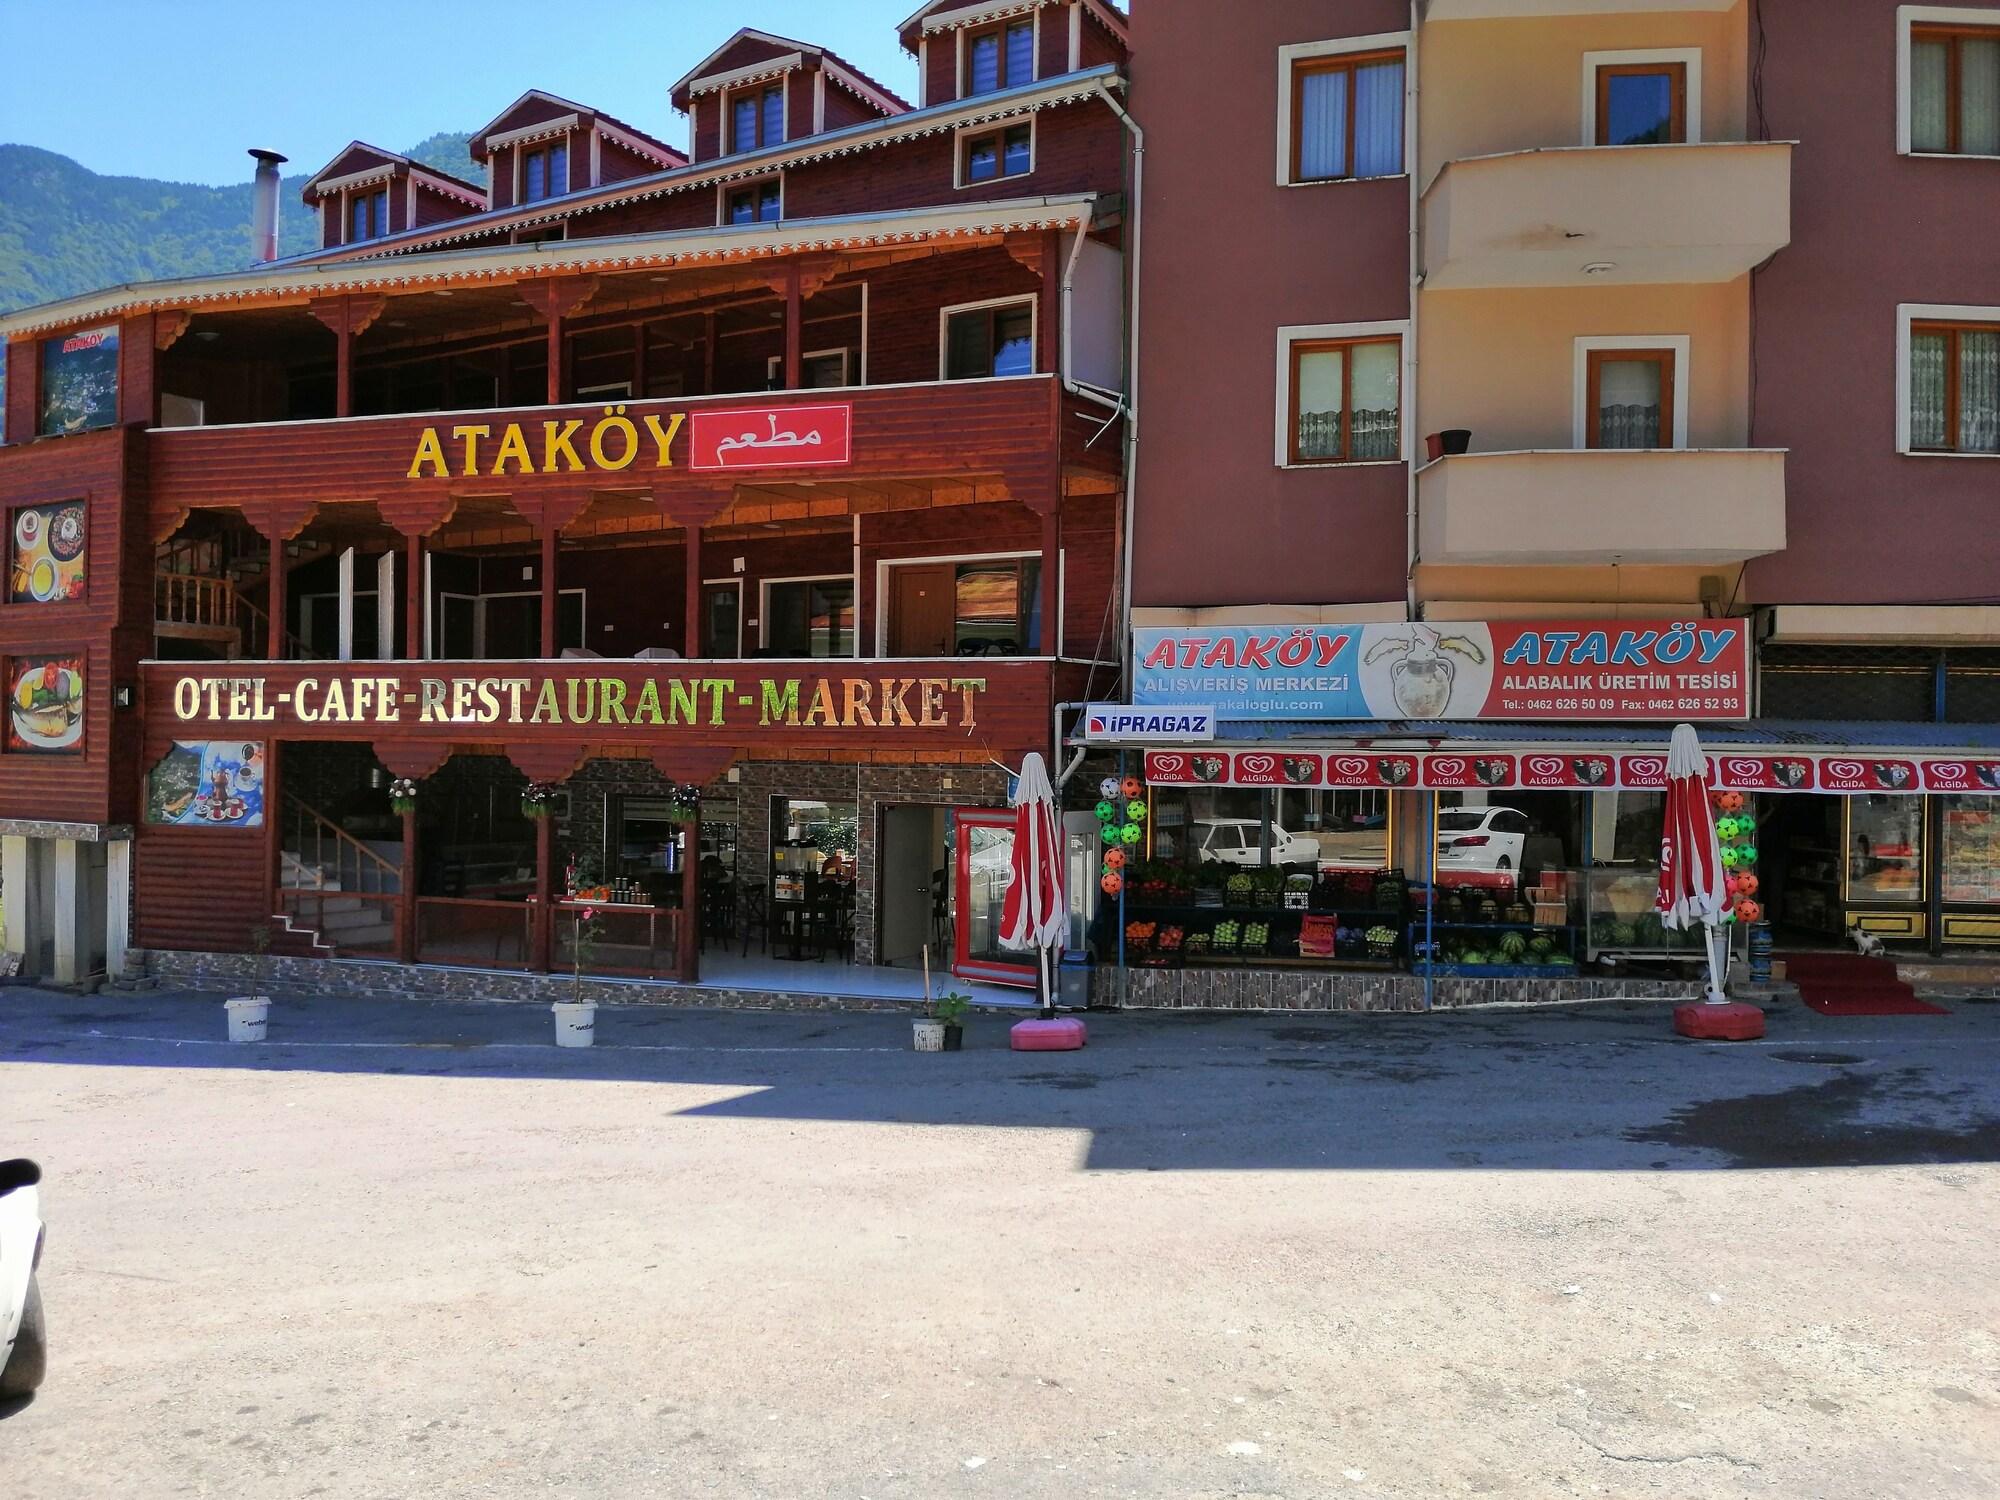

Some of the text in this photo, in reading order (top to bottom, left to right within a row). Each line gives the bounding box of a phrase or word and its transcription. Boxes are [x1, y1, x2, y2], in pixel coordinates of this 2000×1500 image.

[406, 404, 686, 479] ATAKÖY
[715, 413, 822, 466] مطعم
[1143, 628, 1351, 670] ATAKÖY
[1503, 622, 1737, 667] ATAKÖY
[1143, 673, 1349, 696] ALIŞVERİŞ MERKEZİ
[1502, 670, 1738, 690] ALABALIK ÜRETİM TESİSİ
[1527, 699, 1553, 710] 0462
[1555, 698, 1578, 710] 626
[1581, 698, 1596, 710] 50
[1599, 698, 1615, 710] 09
[1621, 699, 1645, 710] Fax:
[1648, 699, 1675, 710] 0462
[1677, 698, 1701, 710] 626
[1704, 698, 1719, 709] 52
[1722, 698, 1739, 709] 93
